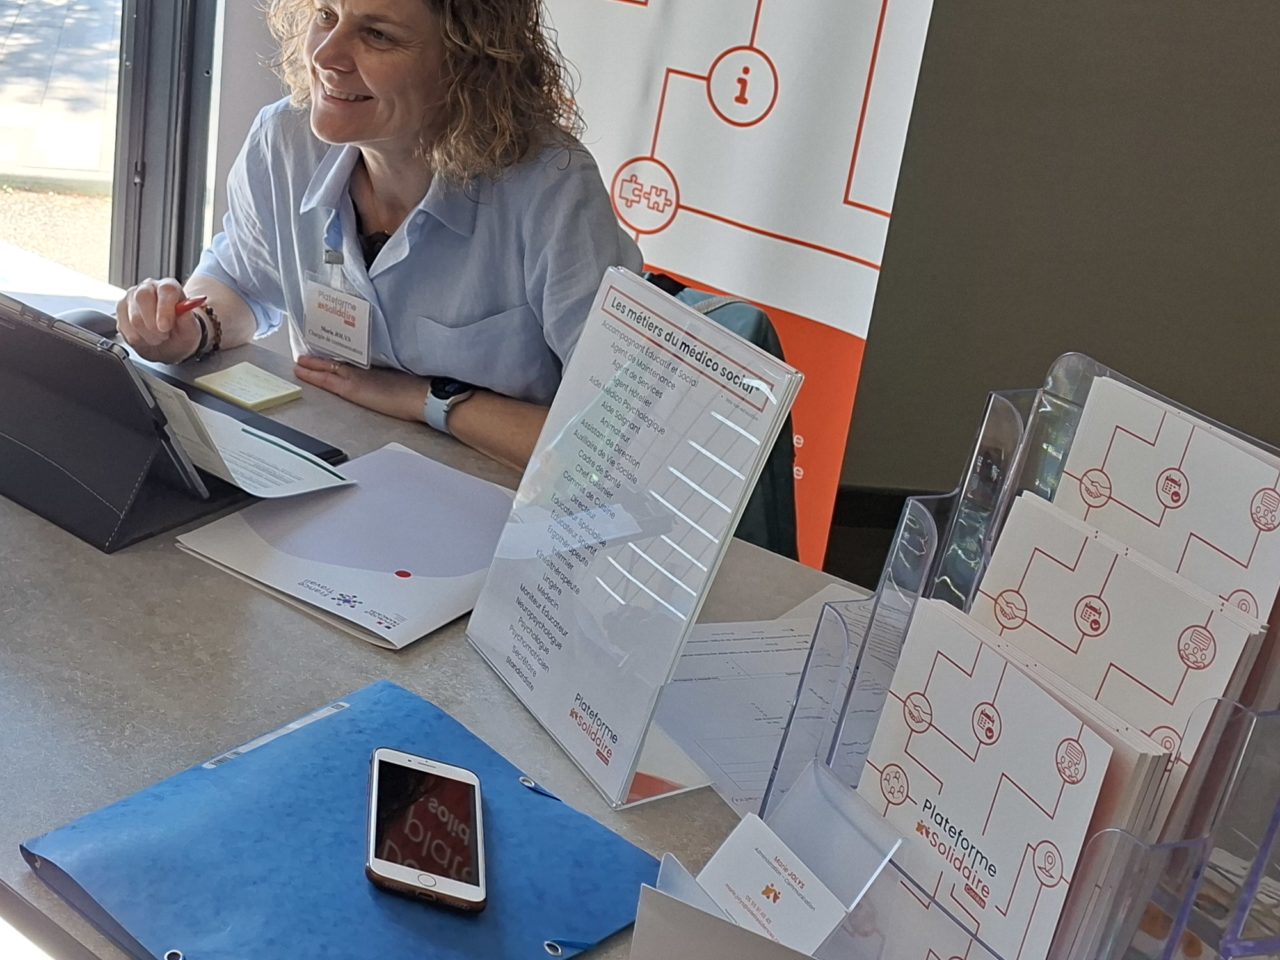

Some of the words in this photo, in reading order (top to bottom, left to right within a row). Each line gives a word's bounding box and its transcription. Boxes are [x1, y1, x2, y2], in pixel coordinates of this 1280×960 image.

[611, 296, 626, 314] Les
[627, 308, 664, 338] métiers
[664, 330, 678, 347] du
[679, 339, 720, 372] médico
[601, 320, 646, 354] Accompagnant
[670, 365, 679, 375] et
[678, 370, 699, 388] Social
[610, 342, 628, 358] Agent
[628, 354, 636, 364] de
[636, 359, 676, 390] Maintenance
[628, 371, 638, 380] de
[637, 376, 664, 398] Services
[629, 387, 652, 408] Hôtelier
[589, 376, 602, 388] Aide
[622, 399, 666, 435] Psychologique
[601, 401, 614, 414] Aide
[614, 410, 640, 434] Soignant
[576, 464, 590, 480] Chef
[578, 449, 596, 468] Cadre
[596, 465, 604, 474] de
[604, 470, 621, 489] Santé
[598, 450, 606, 459] de
[606, 455, 616, 467] Vie
[616, 462, 638, 484] Sociale
[606, 439, 614, 448] de
[614, 444, 640, 470] Direction
[586, 491, 594, 502] de
[594, 496, 616, 520] Cuisine
[578, 536, 598, 556] Sportif
[516, 596, 562, 650] Neuropsychologue
[518, 616, 550, 655] Psychologue
[574, 692, 618, 744] Plateforme
[577, 714, 612, 758] Solidaire
[922, 798, 998, 878] Plateforme
[773, 856, 788, 873] Marie
[788, 871, 806, 890] JOLYS
[928, 834, 990, 898] Solidaire
